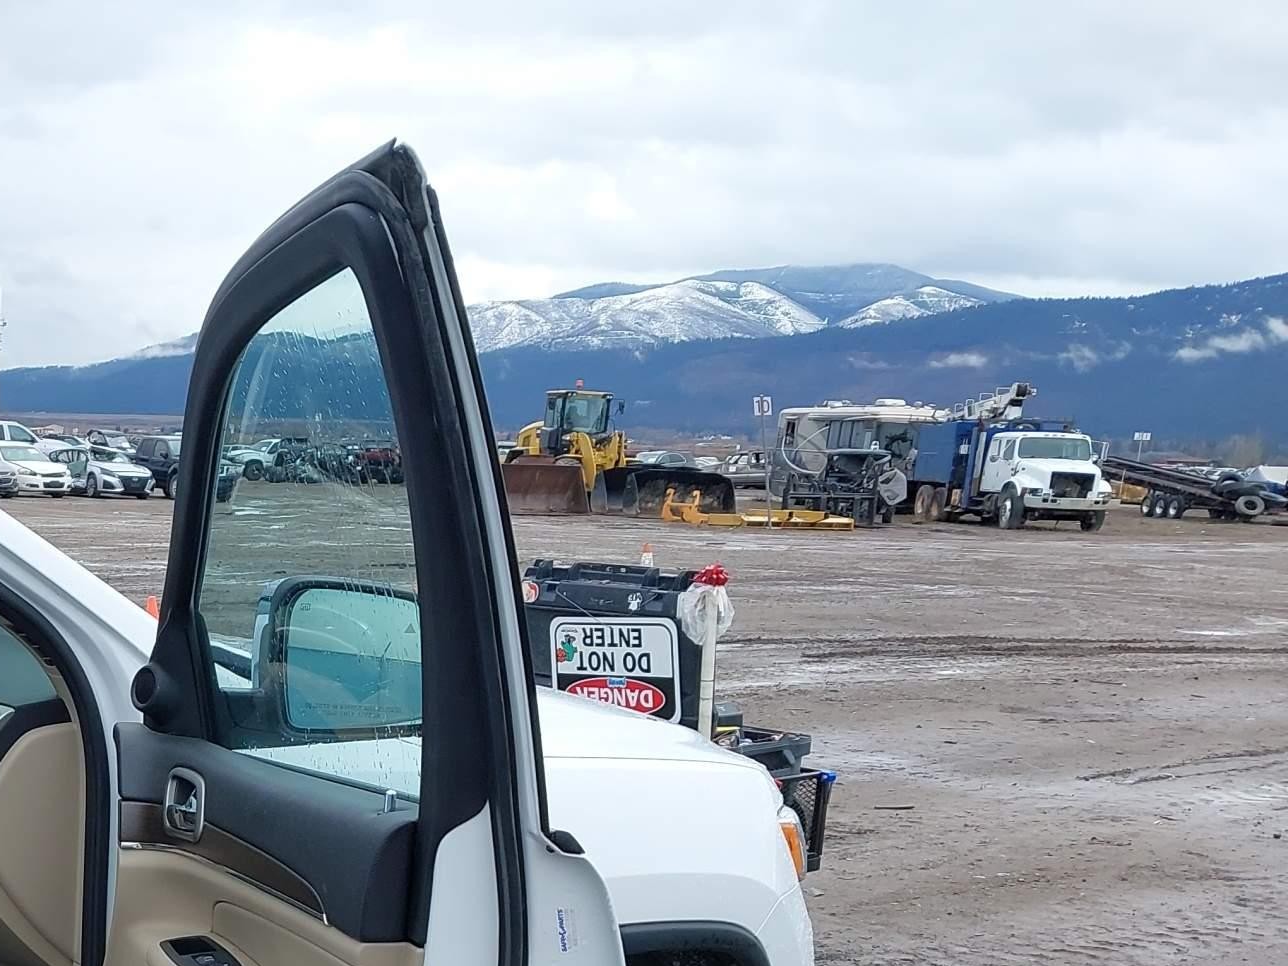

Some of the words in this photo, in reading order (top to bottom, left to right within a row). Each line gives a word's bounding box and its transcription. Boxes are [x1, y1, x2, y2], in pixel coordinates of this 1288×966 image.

[755, 399, 770, 413] 10
[582, 627, 643, 648] ENTER
[576, 651, 615, 672] NOT
[623, 652, 651, 673] DO
